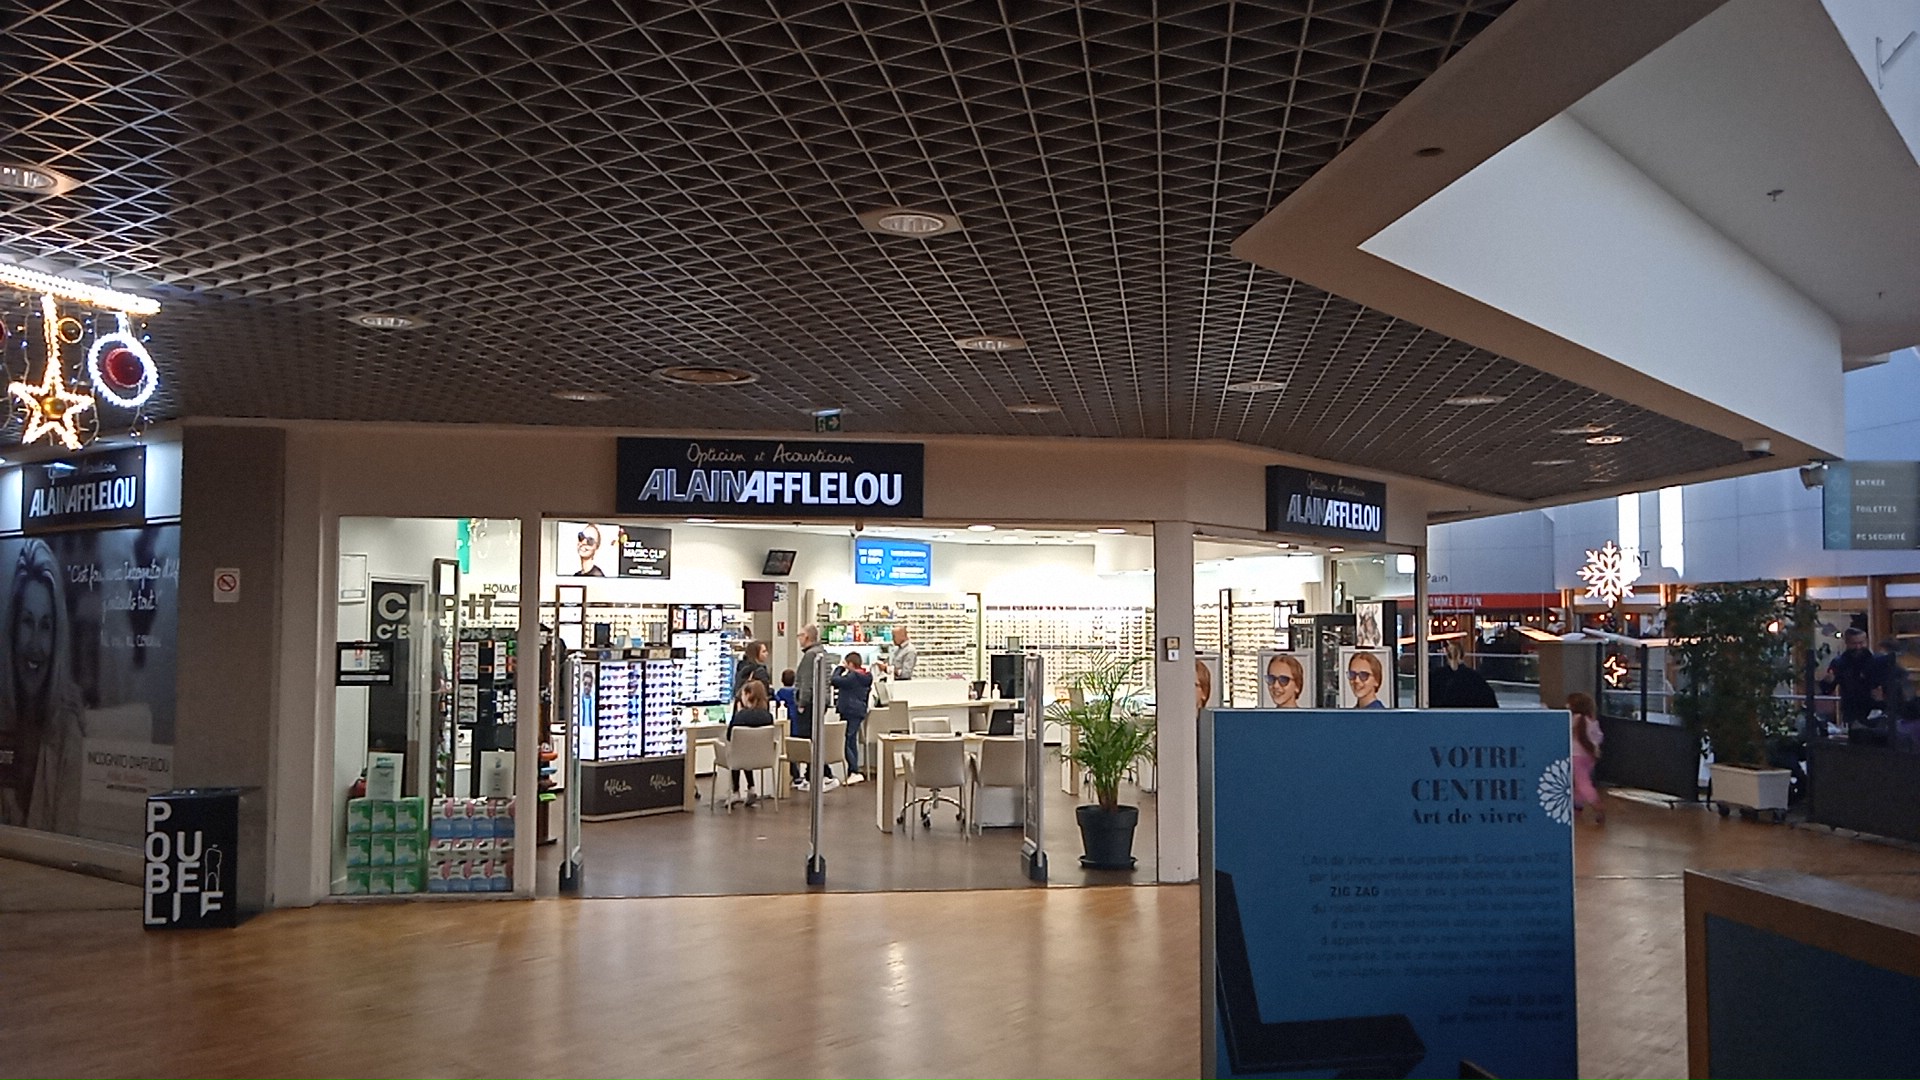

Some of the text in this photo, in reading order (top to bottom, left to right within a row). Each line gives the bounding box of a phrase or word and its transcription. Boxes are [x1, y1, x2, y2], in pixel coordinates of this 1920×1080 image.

[686, 442, 746, 467] Opticien
[772, 443, 854, 464] Acousticien
[1855, 504, 1897, 513] TOILETTES
[1428, 595, 1454, 608] OMME
[1463, 595, 1483, 608] PAIN
[1429, 745, 1527, 770] VOTRE
[1411, 778, 1527, 802] CENTRE
[1412, 807, 1528, 825] Art de vivre
[1329, 886, 1351, 898] ZIG
[1354, 886, 1380, 898] ZAG
